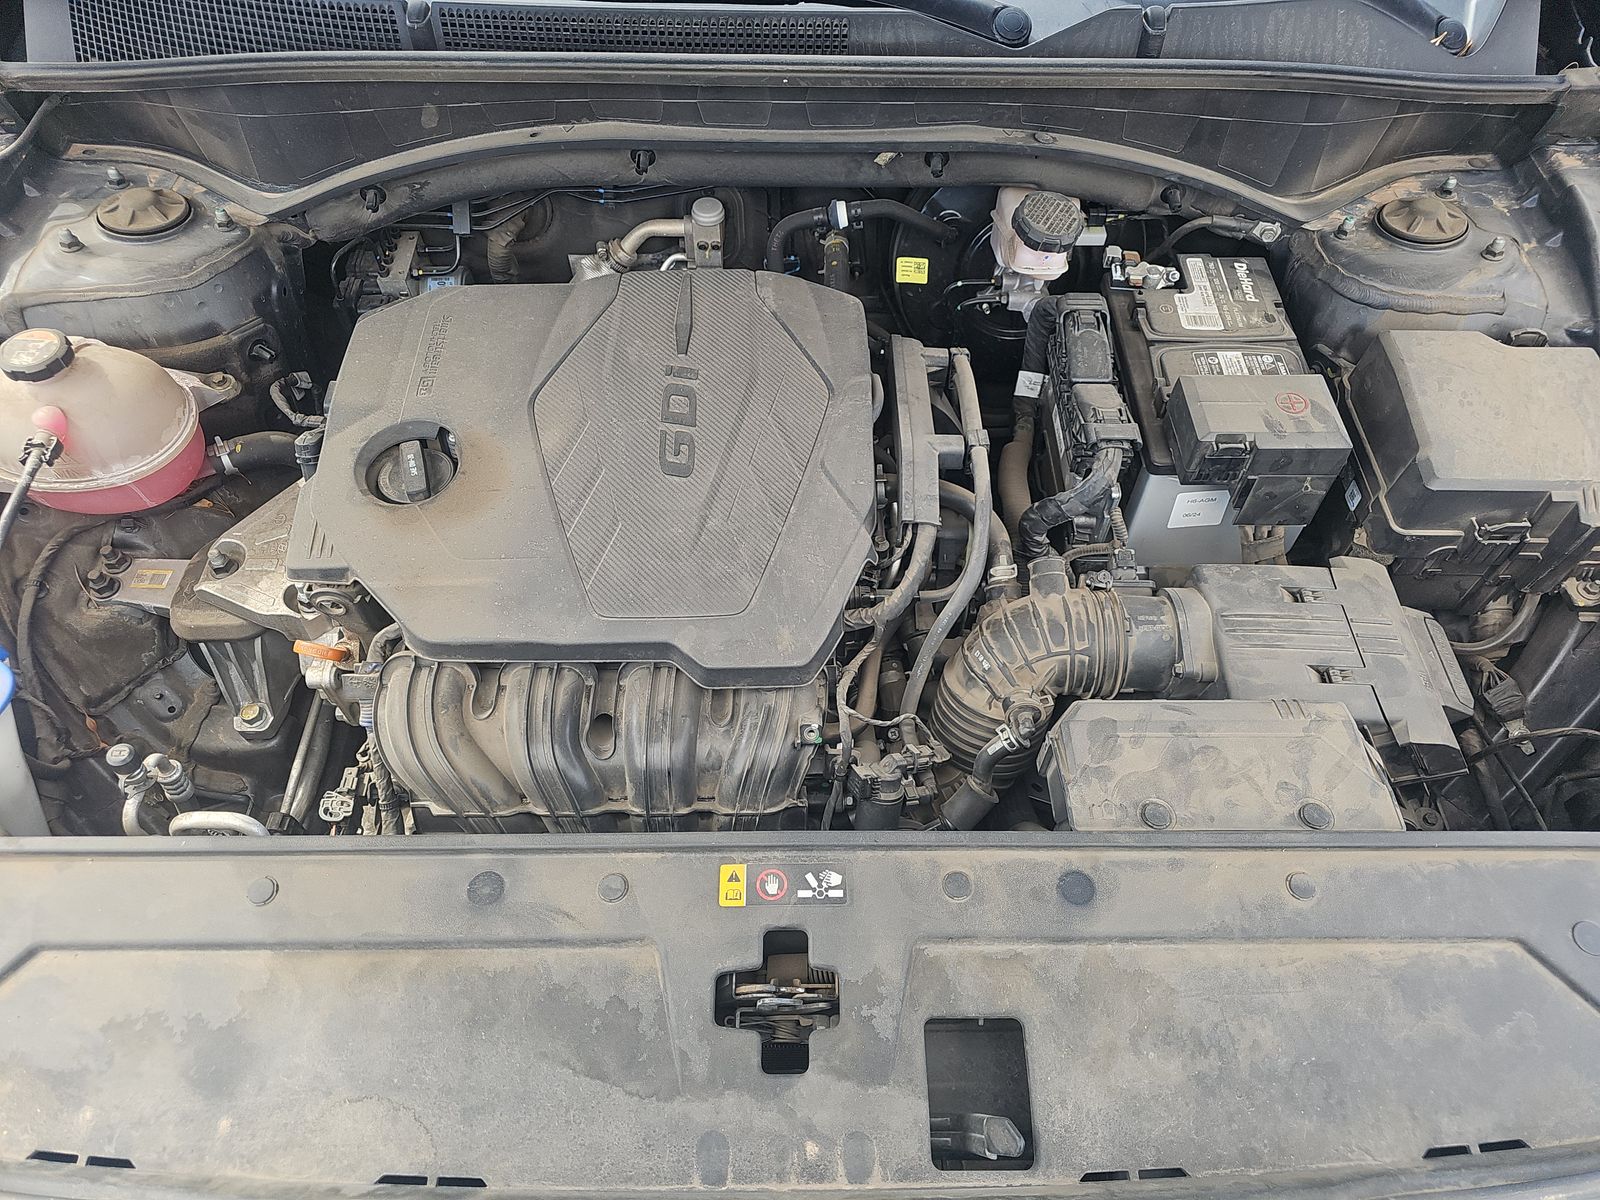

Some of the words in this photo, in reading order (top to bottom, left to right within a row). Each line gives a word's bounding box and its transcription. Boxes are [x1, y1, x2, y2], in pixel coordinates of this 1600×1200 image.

[1233, 262, 1260, 302] DieHard
[422, 321, 441, 374] TECHNOLOGY
[429, 314, 453, 375] Smartstream
